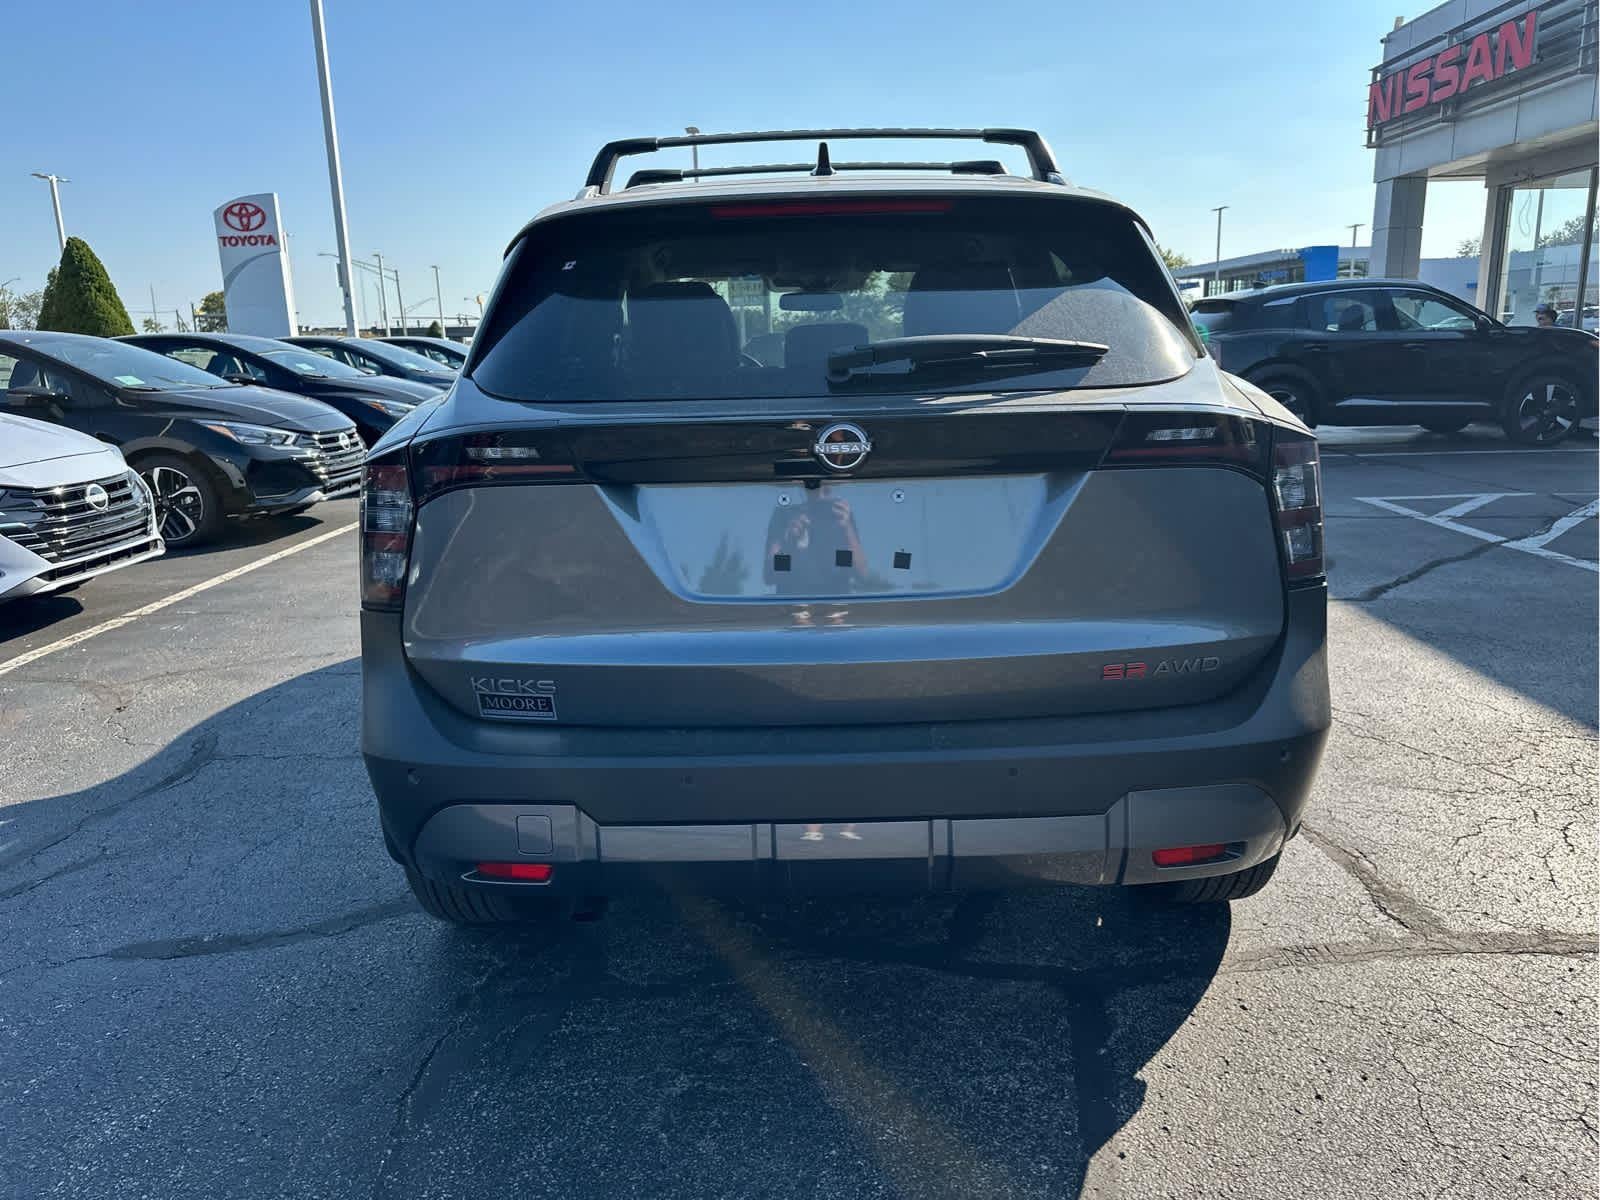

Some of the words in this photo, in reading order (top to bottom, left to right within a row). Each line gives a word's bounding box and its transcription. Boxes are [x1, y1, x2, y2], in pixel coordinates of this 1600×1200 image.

[1367, 11, 1537, 129] NISSAN
[218, 234, 277, 247] TOYOTA
[814, 442, 871, 454] NISSAN
[1103, 662, 1147, 680] SR
[1153, 656, 1220, 677] AWD
[470, 677, 557, 694] KICKS
[485, 696, 549, 712] MOORE
